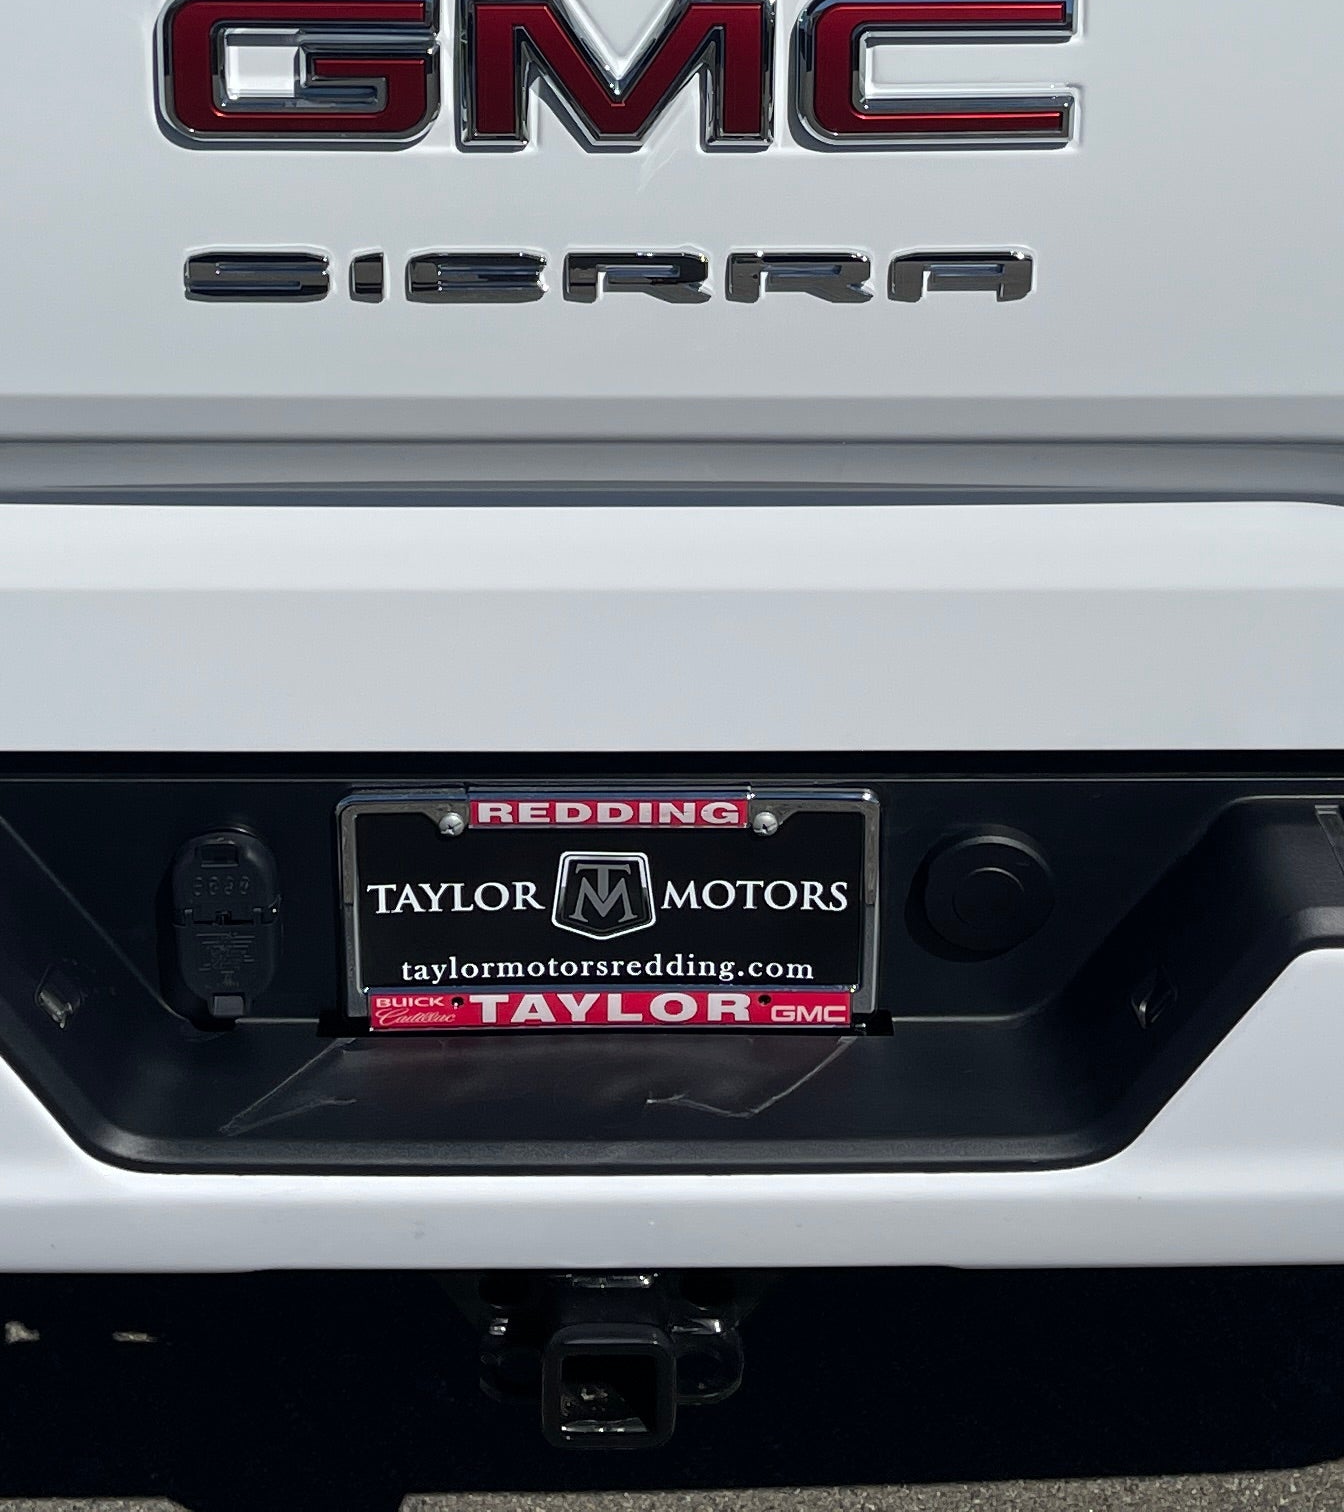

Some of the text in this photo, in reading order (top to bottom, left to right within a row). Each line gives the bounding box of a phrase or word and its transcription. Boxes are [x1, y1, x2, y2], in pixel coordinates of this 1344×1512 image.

[183, 249, 1033, 303] SIERRA
[476, 800, 740, 824] REDDING
[366, 882, 545, 915] TAYLOR
[660, 880, 849, 913] MOTORS
[401, 953, 814, 983] taylormotorsredding.com
[374, 1005, 848, 1026] Cadillac GMC
[375, 993, 752, 1023] BUICK TAYLOR
